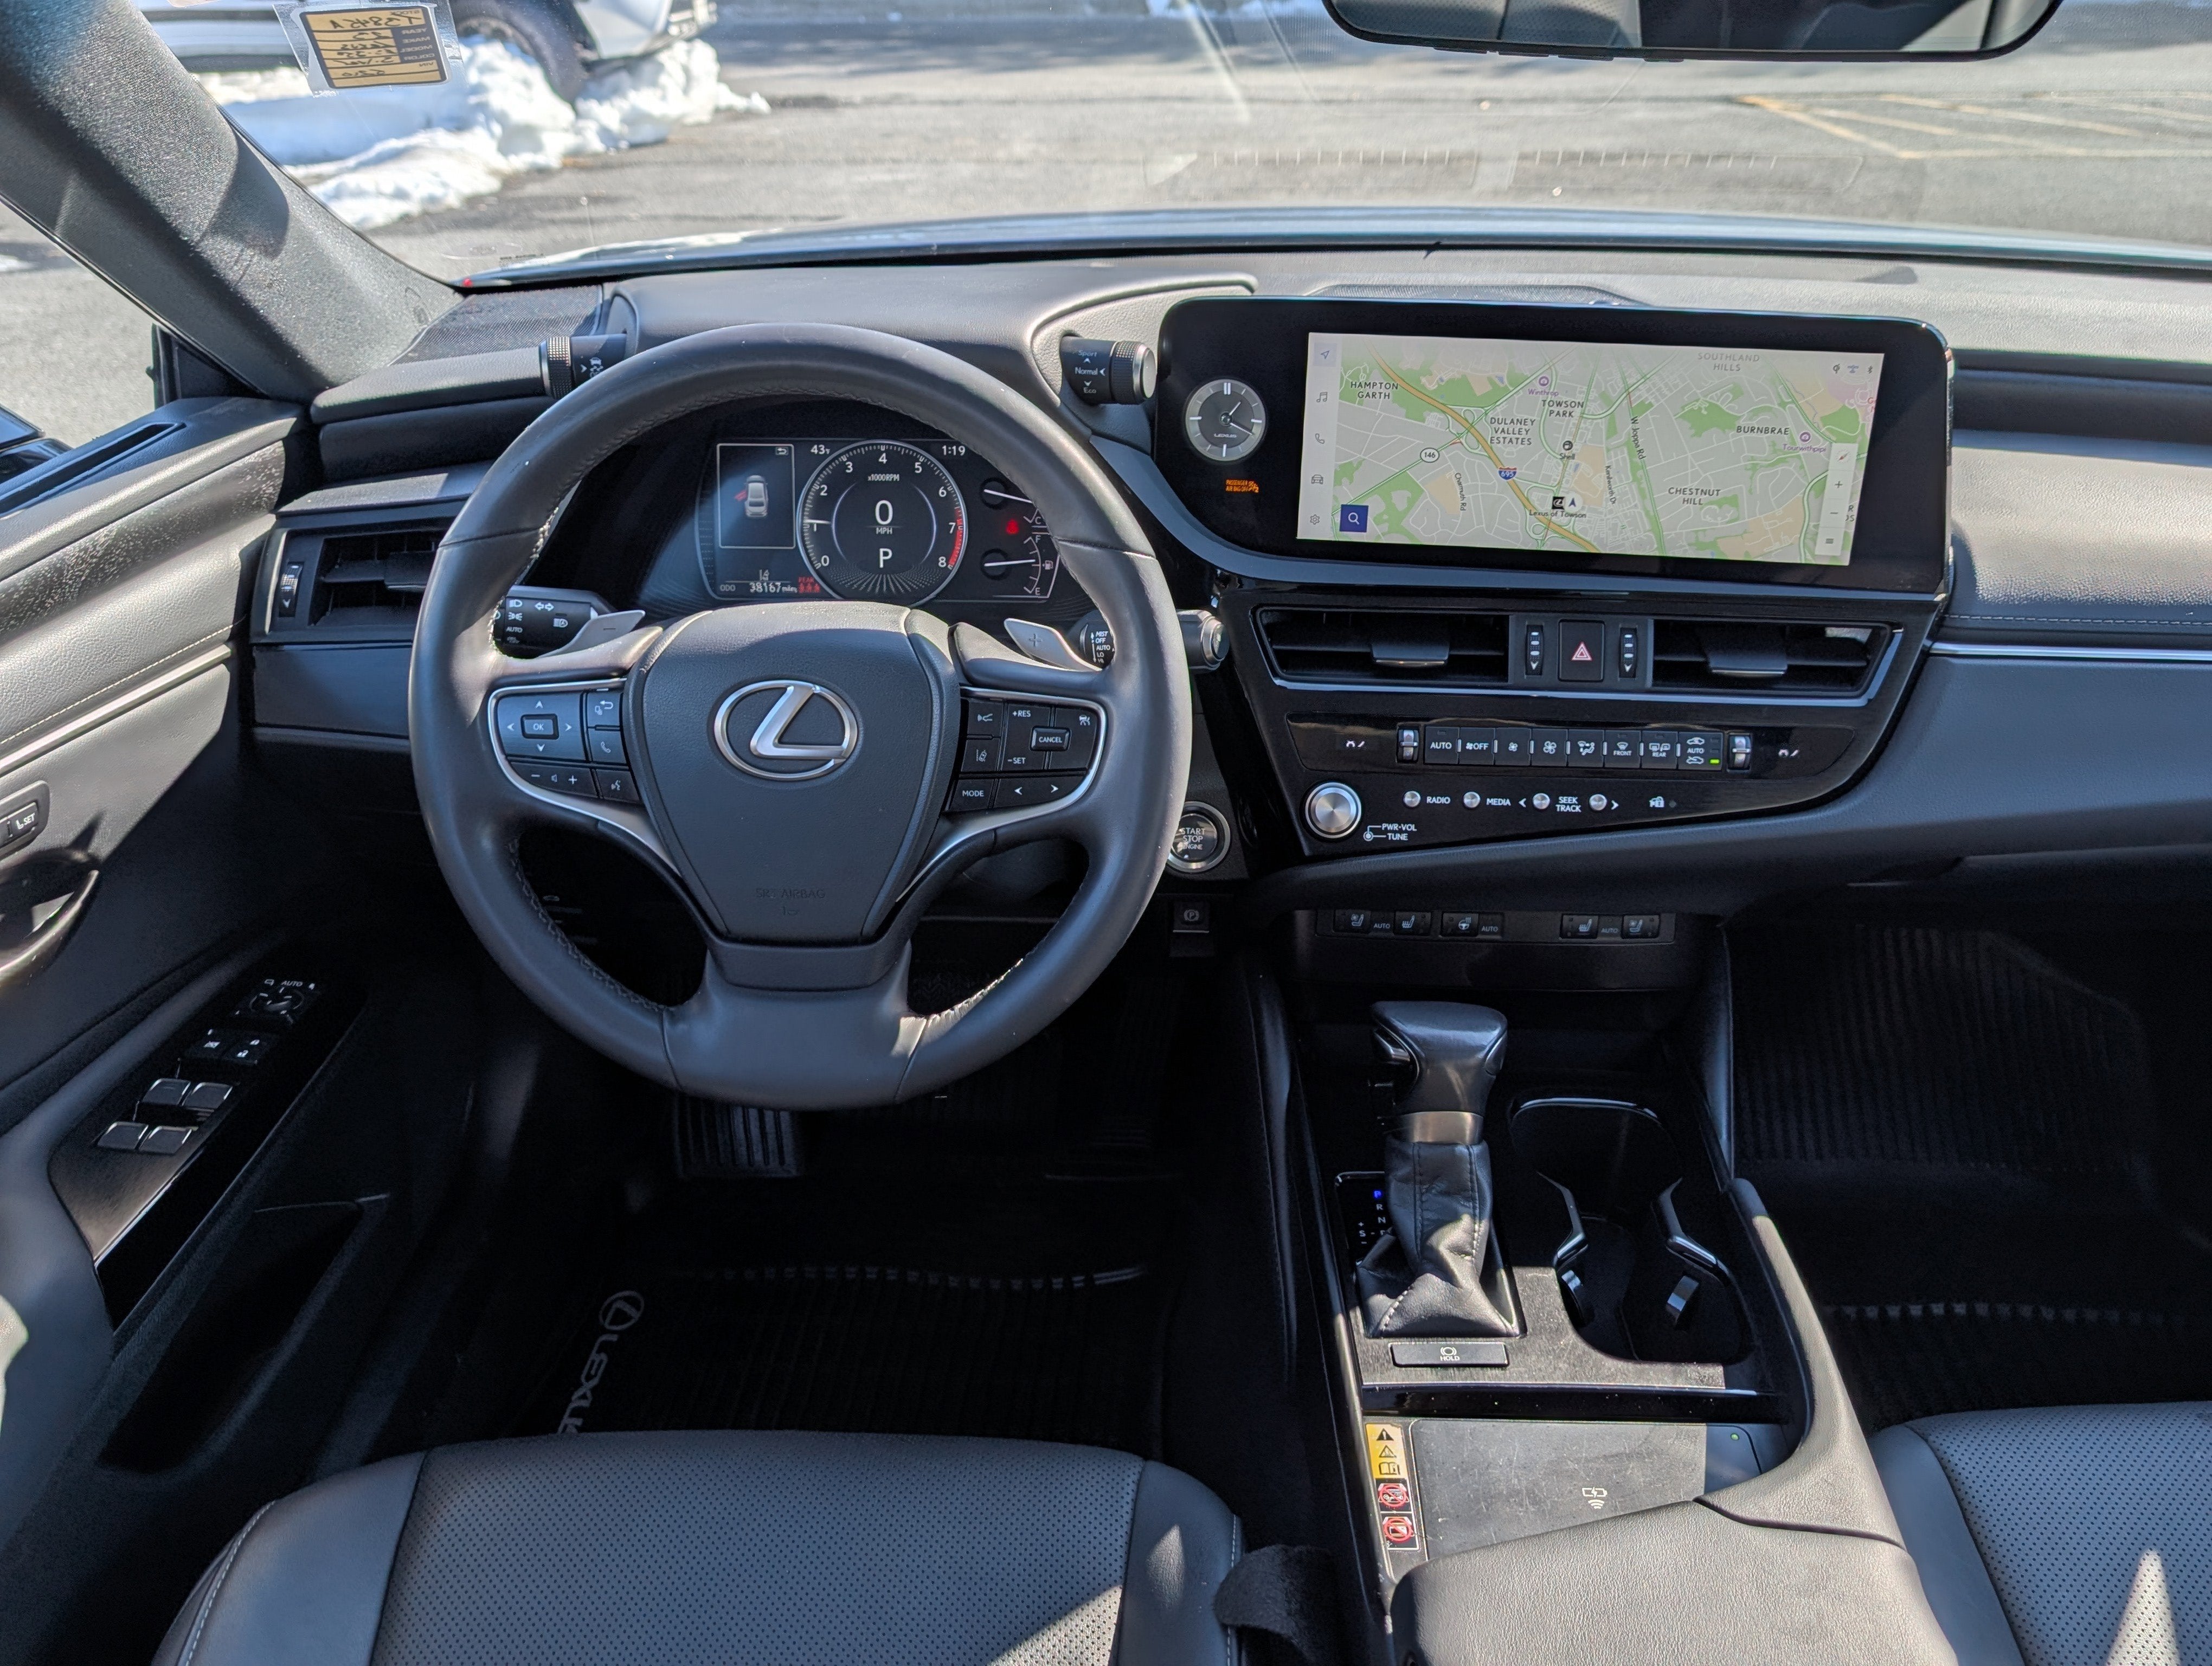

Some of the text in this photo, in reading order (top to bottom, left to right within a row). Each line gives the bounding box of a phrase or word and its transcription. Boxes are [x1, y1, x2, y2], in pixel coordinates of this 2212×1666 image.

[1697, 353, 1760, 363] SOUTHLAND
[1075, 367, 1098, 376] Normal
[1713, 363, 1741, 372] HILLS
[1351, 381, 1399, 390] HAMPTON
[1358, 390, 1391, 400] GARTH
[1528, 388, 1559, 397] Winthrop
[1541, 400, 1584, 408] TOWSON
[1549, 409, 1574, 418] PARK
[1490, 417, 1536, 427] DULANEY
[1494, 427, 1531, 436] VALLEY
[1736, 425, 1790, 435] BURNBRAE
[1490, 436, 1532, 446] ESTATES
[1631, 416, 1647, 460] W Joppa Rd
[942, 445, 966, 456] 1:19
[879, 453, 887, 464] 4
[1559, 452, 1576, 460] Shell
[845, 462, 853, 473] 3
[915, 462, 922, 473] 5
[820, 485, 828, 496] 2
[938, 486, 947, 497] 6
[1455, 472, 1467, 511] Charmuth Rd
[1668, 487, 1721, 496] CHESTNUT
[1682, 497, 1703, 505] HILL
[874, 499, 893, 524] 0
[1550, 509, 1558, 517] of
[876, 527, 892, 535] MPH
[949, 522, 956, 534] 7
[821, 555, 829, 566] 0
[879, 549, 892, 568] P
[938, 556, 947, 568] 8
[749, 581, 781, 593] 38167
[1035, 587, 1040, 595] E
[1426, 796, 1450, 804] RADIO
[1486, 798, 1511, 806] MEDIA
[1556, 804, 1581, 813] TRACK
[23, 813, 35, 825] SET
[781, 889, 825, 899] AIRBAG
